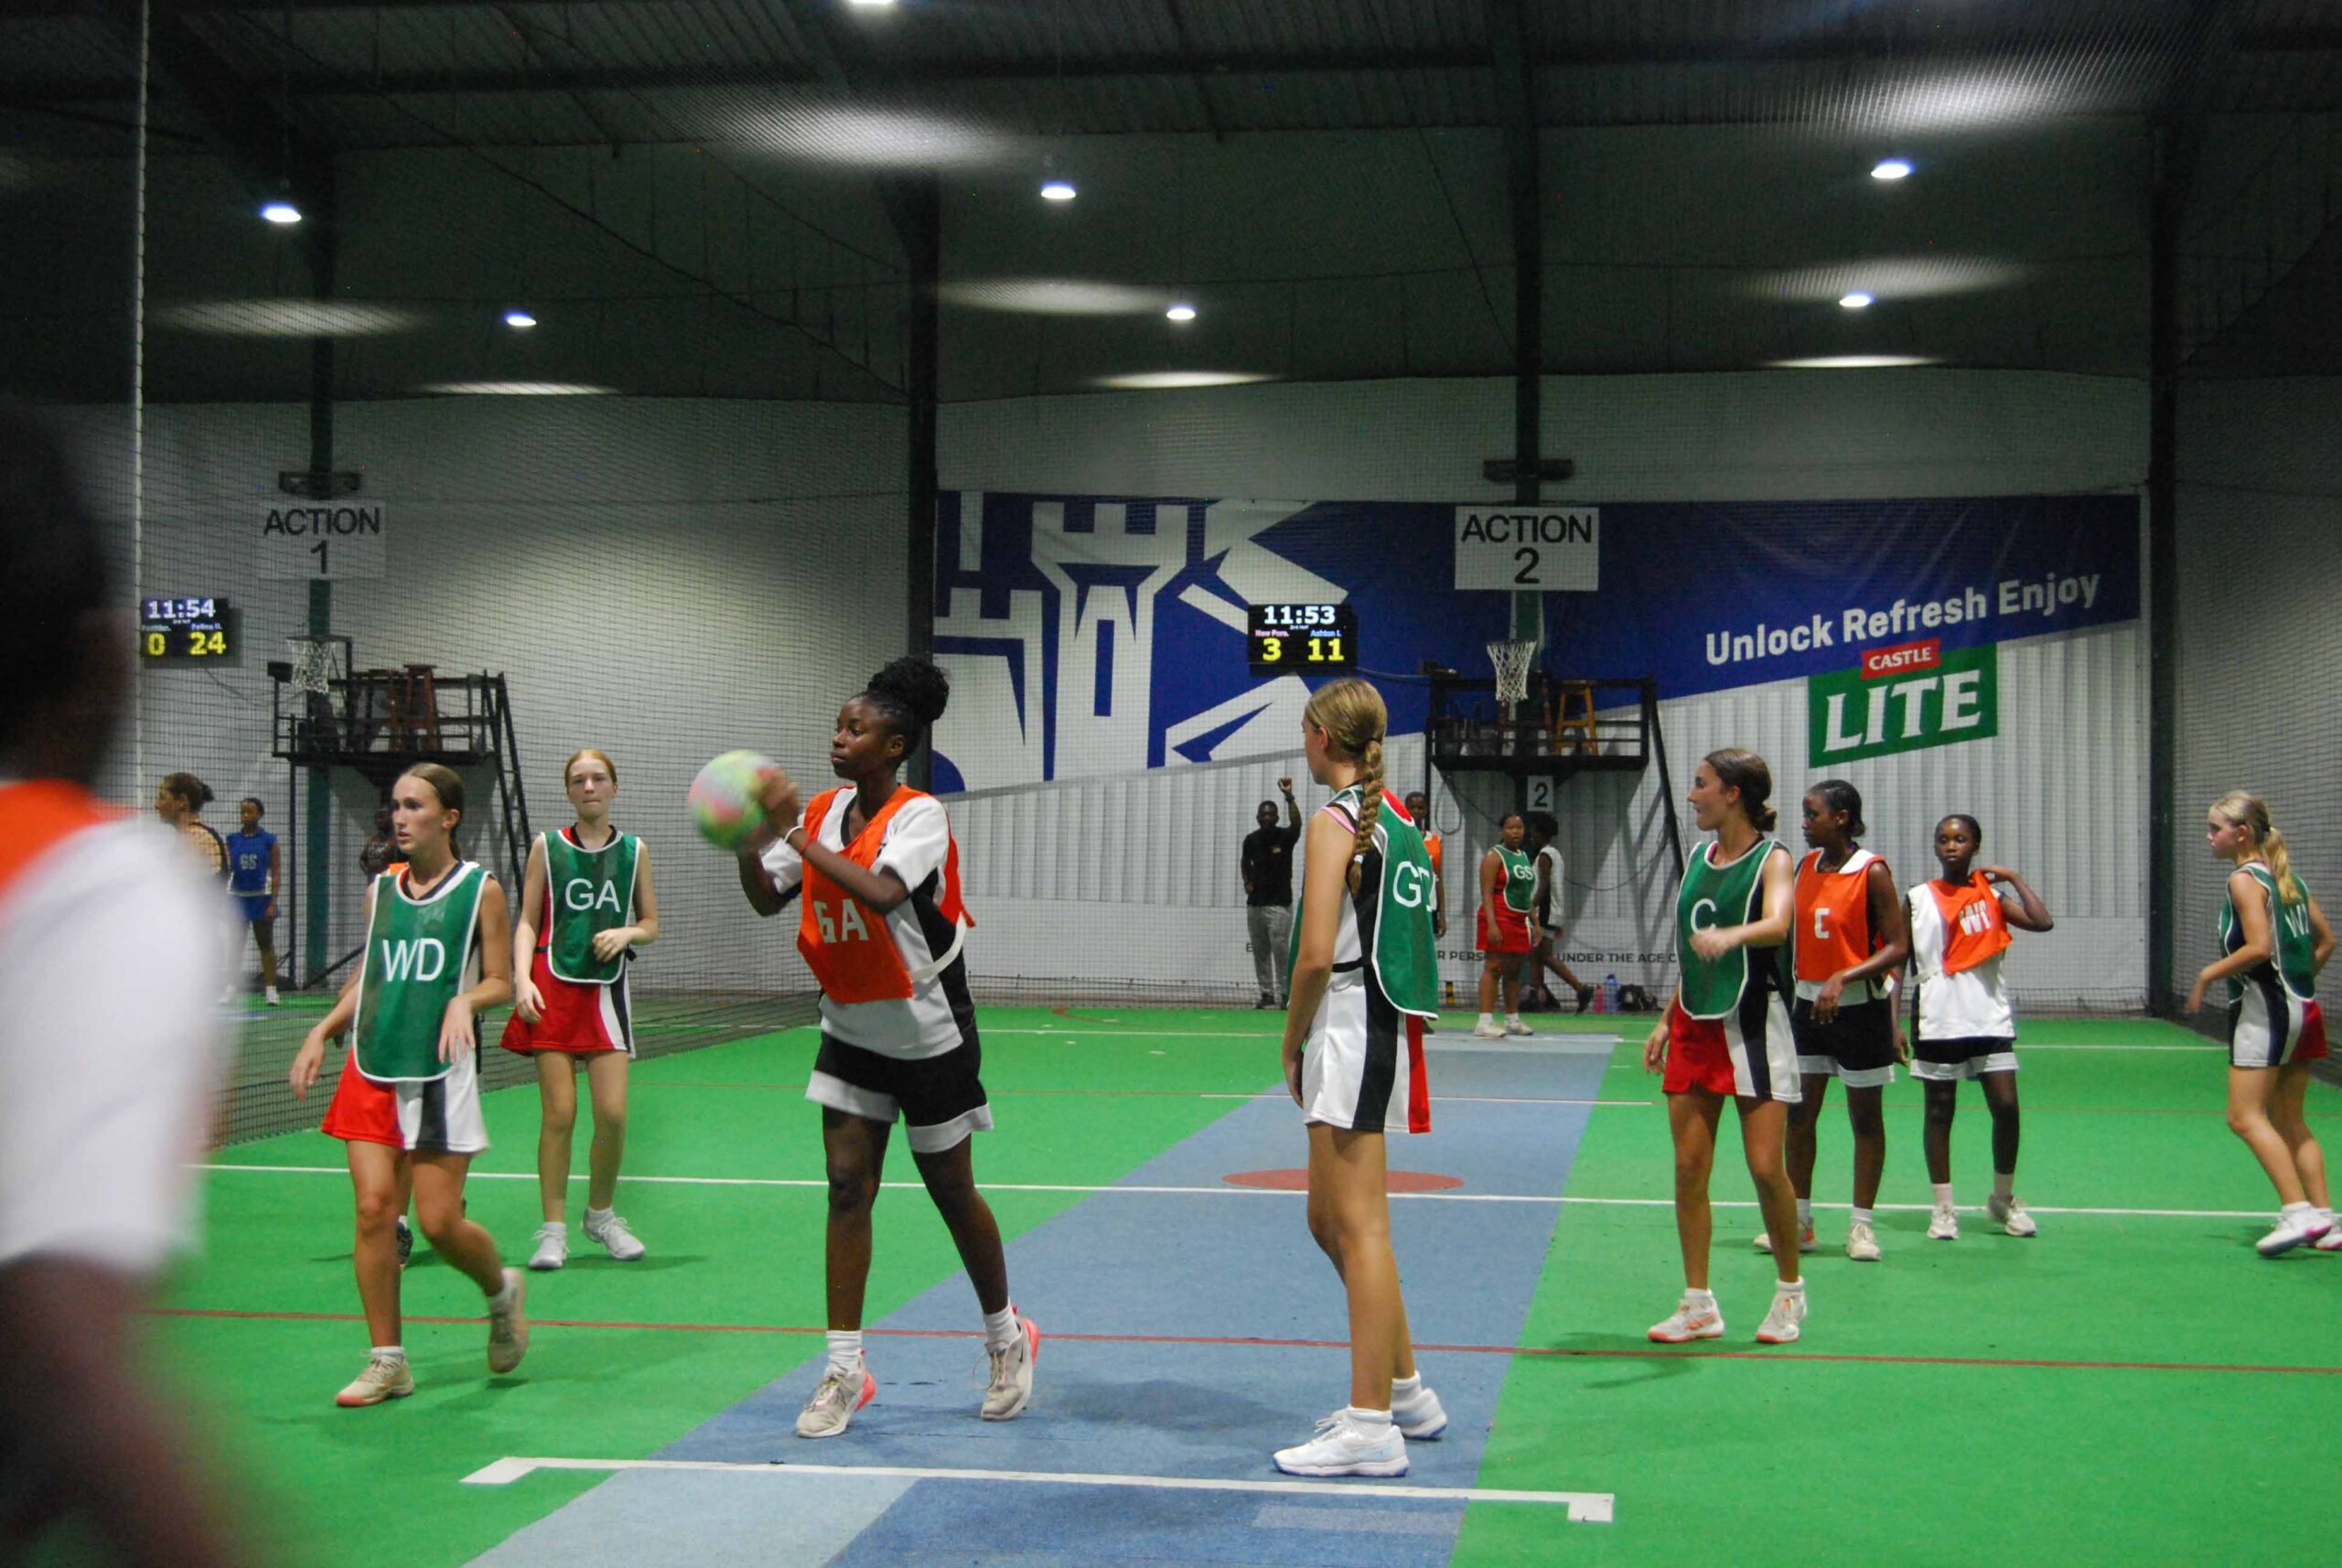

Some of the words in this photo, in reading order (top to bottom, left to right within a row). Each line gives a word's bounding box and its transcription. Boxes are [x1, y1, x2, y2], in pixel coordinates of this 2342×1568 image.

[263, 508, 380, 535] ACTION
[1460, 514, 1592, 542] ACTION
[310, 540, 327, 574] 1
[1514, 547, 1540, 584] 2
[148, 599, 216, 618] 11:54
[1264, 606, 1336, 625] 11:53
[1705, 613, 1834, 666] Unlock
[1842, 585, 1987, 643] Refresh
[1998, 571, 2100, 618] Enjoy
[147, 632, 166, 656] 0
[189, 631, 227, 655] 24
[1262, 637, 1282, 661] 3
[1307, 638, 1345, 661] 11
[1869, 646, 1932, 671] CASTLE
[1822, 669, 1982, 754] LITE
[1534, 782, 1548, 807] 2
[1513, 864, 1533, 880] GS
[564, 878, 621, 913] GA
[381, 938, 446, 983] WD
[1449, 950, 1484, 962] PERS
[1556, 952, 1604, 963] UNDER
[1607, 952, 1635, 963] THE
[1638, 952, 1665, 963] AGE
